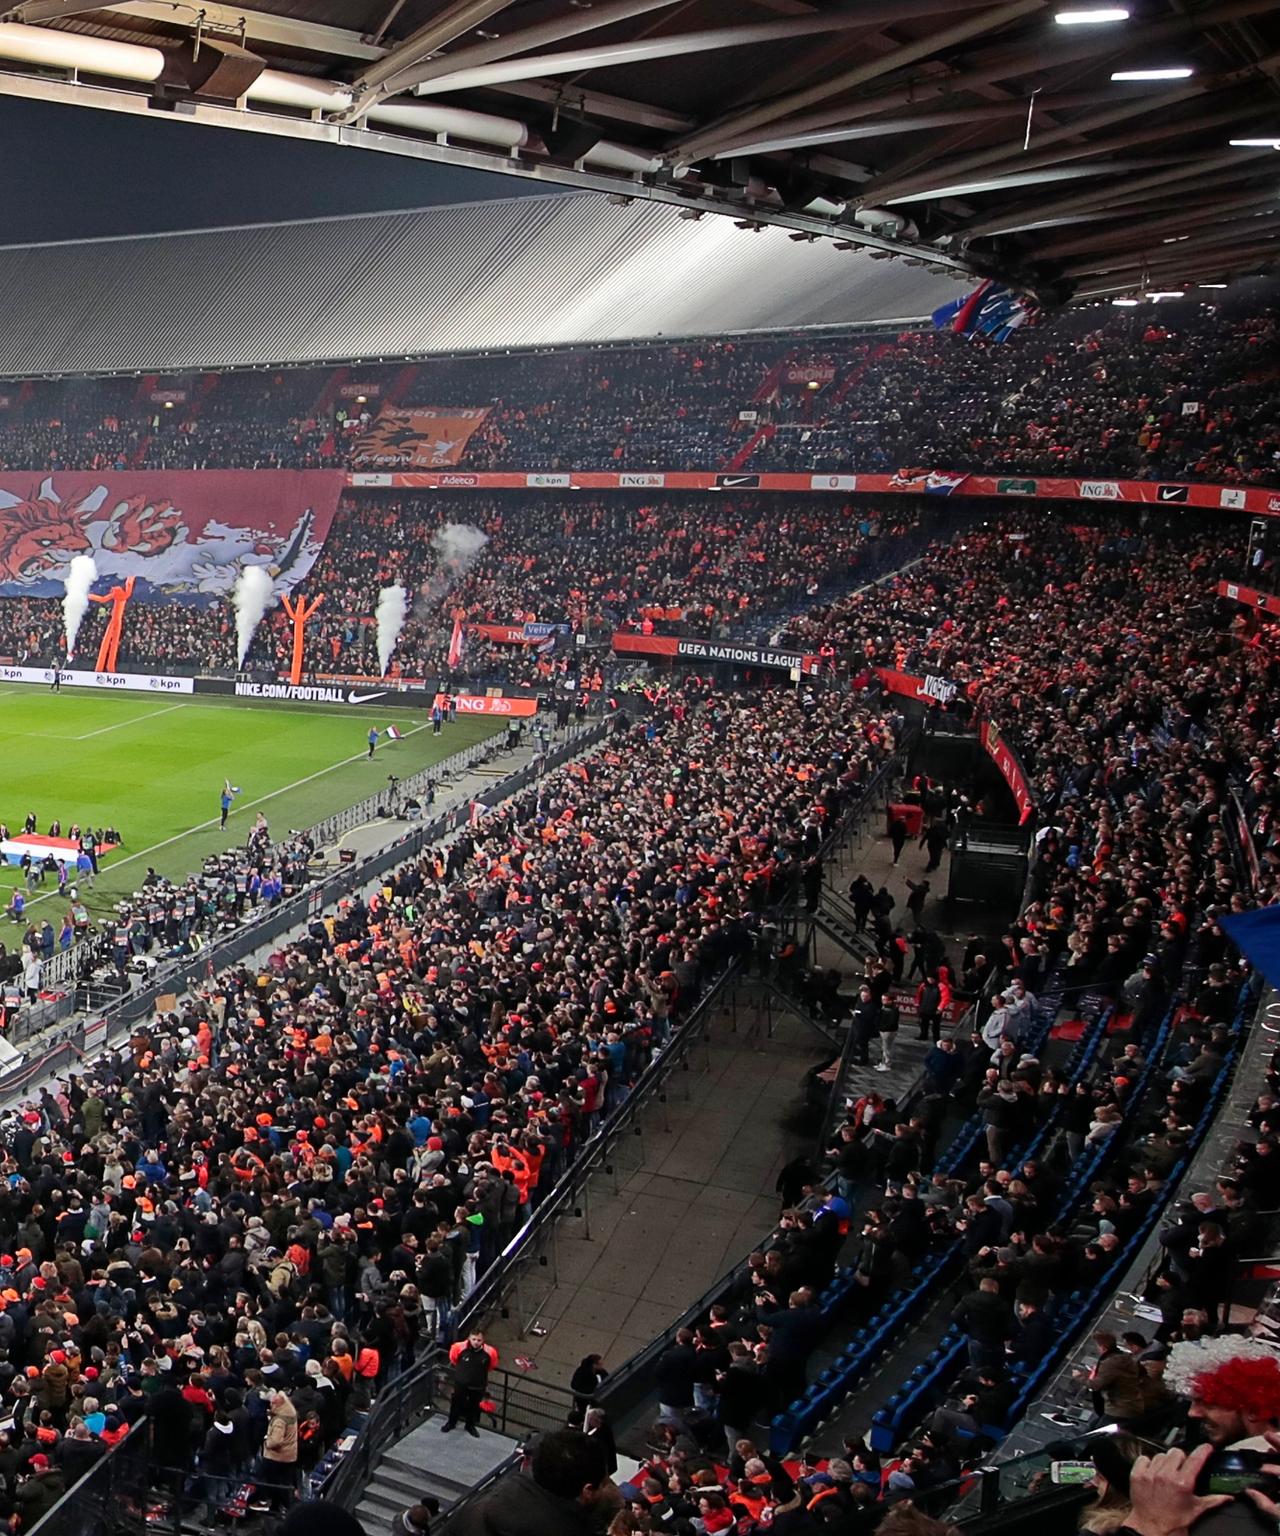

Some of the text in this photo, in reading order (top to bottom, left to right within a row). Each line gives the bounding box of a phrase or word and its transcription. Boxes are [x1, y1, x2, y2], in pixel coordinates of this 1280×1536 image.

[442, 475, 475, 485] Adecco
[545, 477, 562, 486] kpn
[622, 475, 645, 486] ING
[1082, 484, 1101, 496] ING
[678, 642, 802, 668] UEFA NATIONS LEAGUE
[4, 670, 23, 680] kpn
[107, 676, 126, 687] kpn
[160, 680, 181, 690] kpn
[235, 683, 345, 703] NIKE.COM/FOOTBALL
